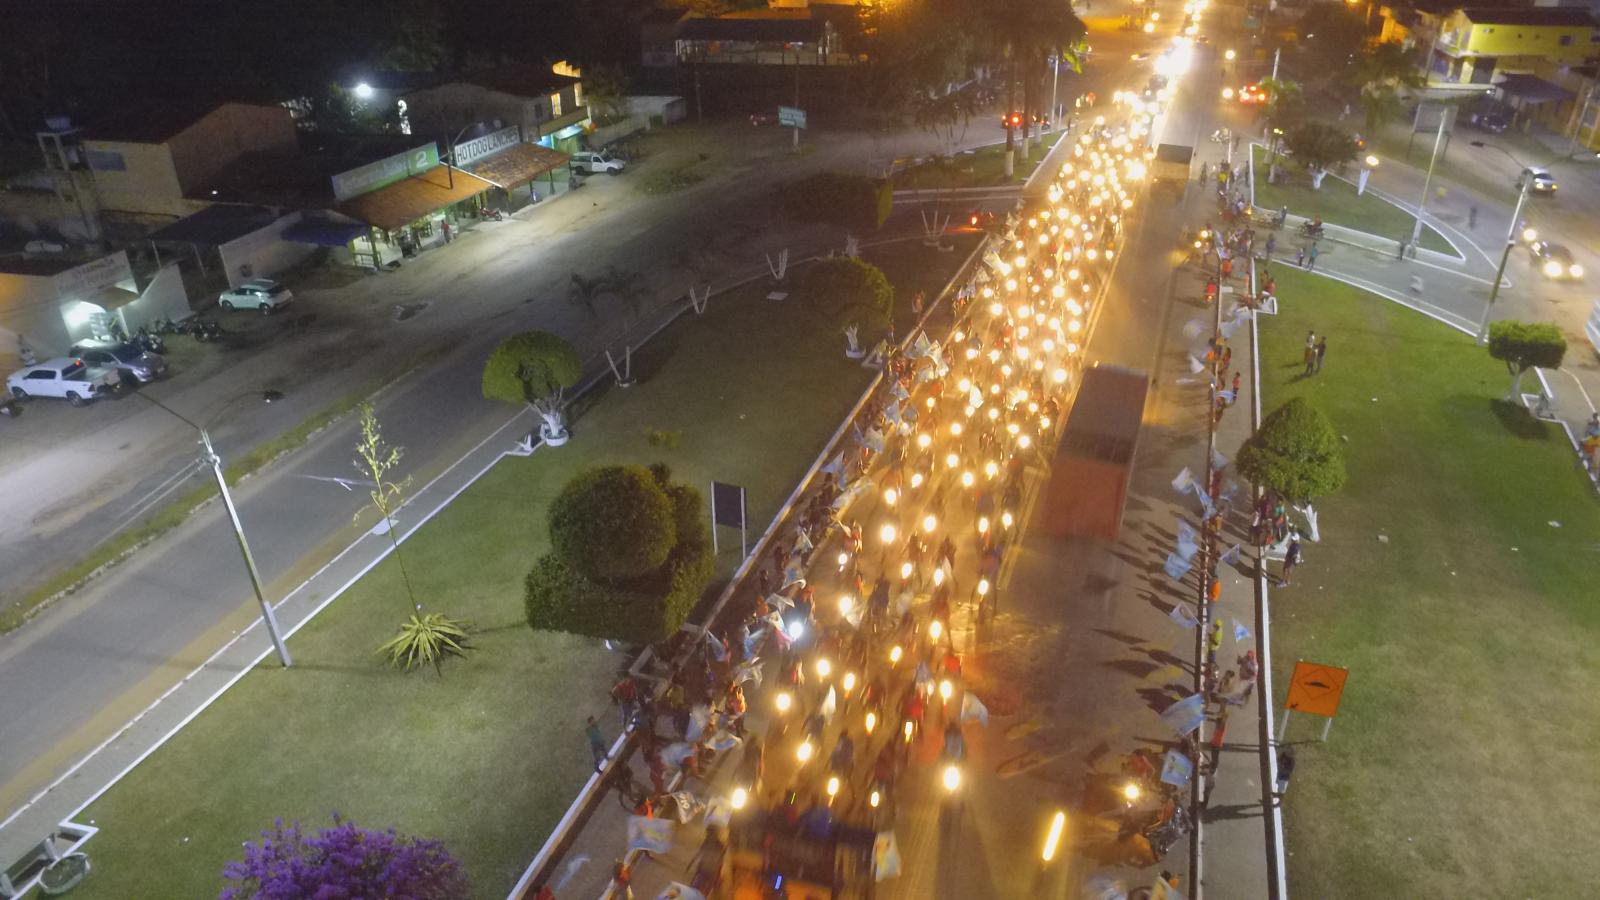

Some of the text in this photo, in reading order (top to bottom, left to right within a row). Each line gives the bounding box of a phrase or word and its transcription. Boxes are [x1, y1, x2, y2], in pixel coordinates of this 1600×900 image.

[415, 151, 429, 169] 2
[456, 143, 472, 162] HOT
[472, 138, 487, 156] DOG
